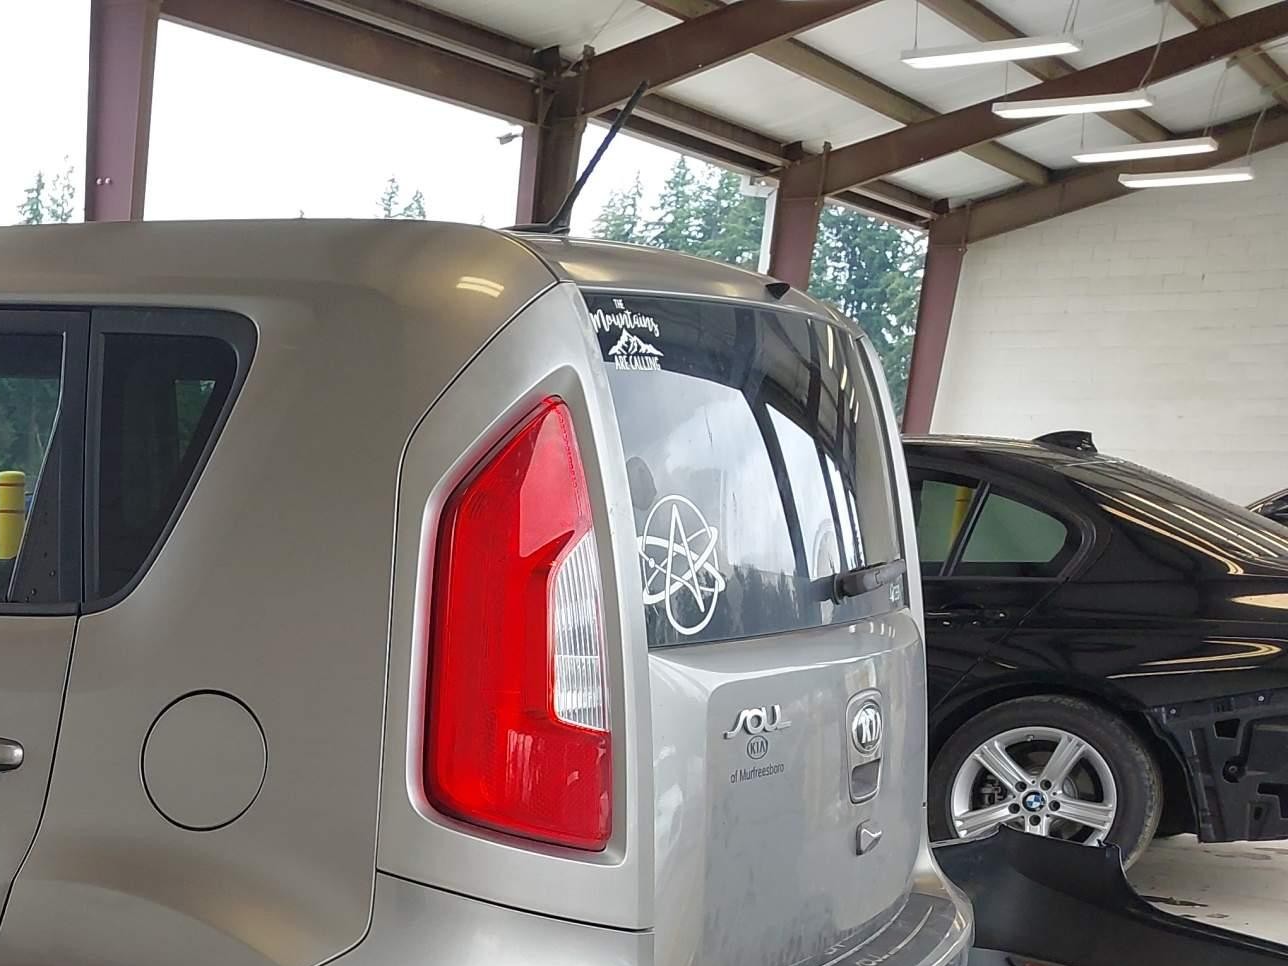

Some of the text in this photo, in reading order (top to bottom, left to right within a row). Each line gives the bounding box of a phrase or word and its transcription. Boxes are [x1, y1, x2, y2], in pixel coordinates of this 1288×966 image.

[613, 299, 625, 309] THE
[590, 308, 660, 337] Mountains
[615, 355, 661, 370] ARE CALLING
[750, 740, 766, 755] KIA
[730, 762, 785, 783] of Murfreesboro
